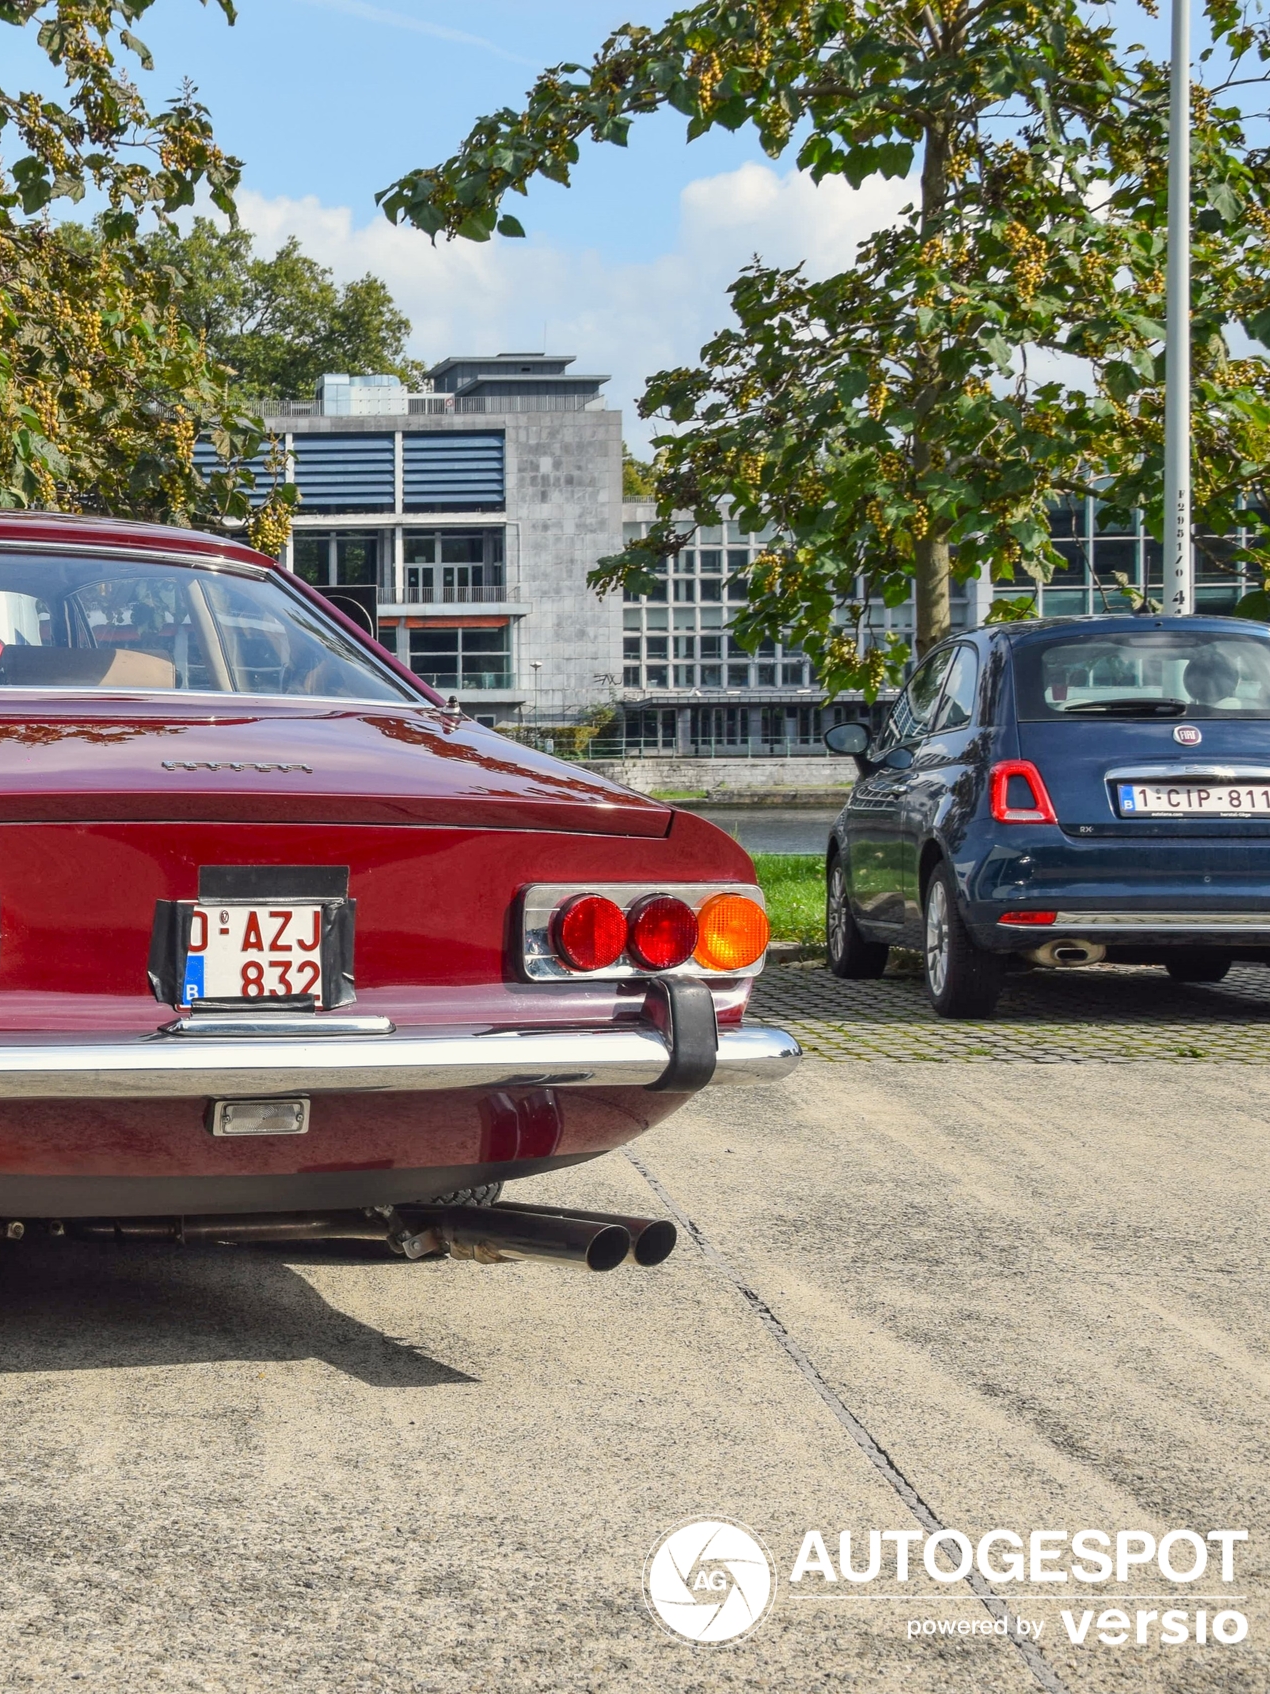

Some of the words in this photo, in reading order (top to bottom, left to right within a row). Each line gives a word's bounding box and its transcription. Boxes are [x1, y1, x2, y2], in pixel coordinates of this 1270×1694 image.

[1179, 730, 1197, 741] FIAT
[1123, 799, 1134, 810] B
[241, 960, 321, 1001] 832
[186, 984, 199, 1001] B
